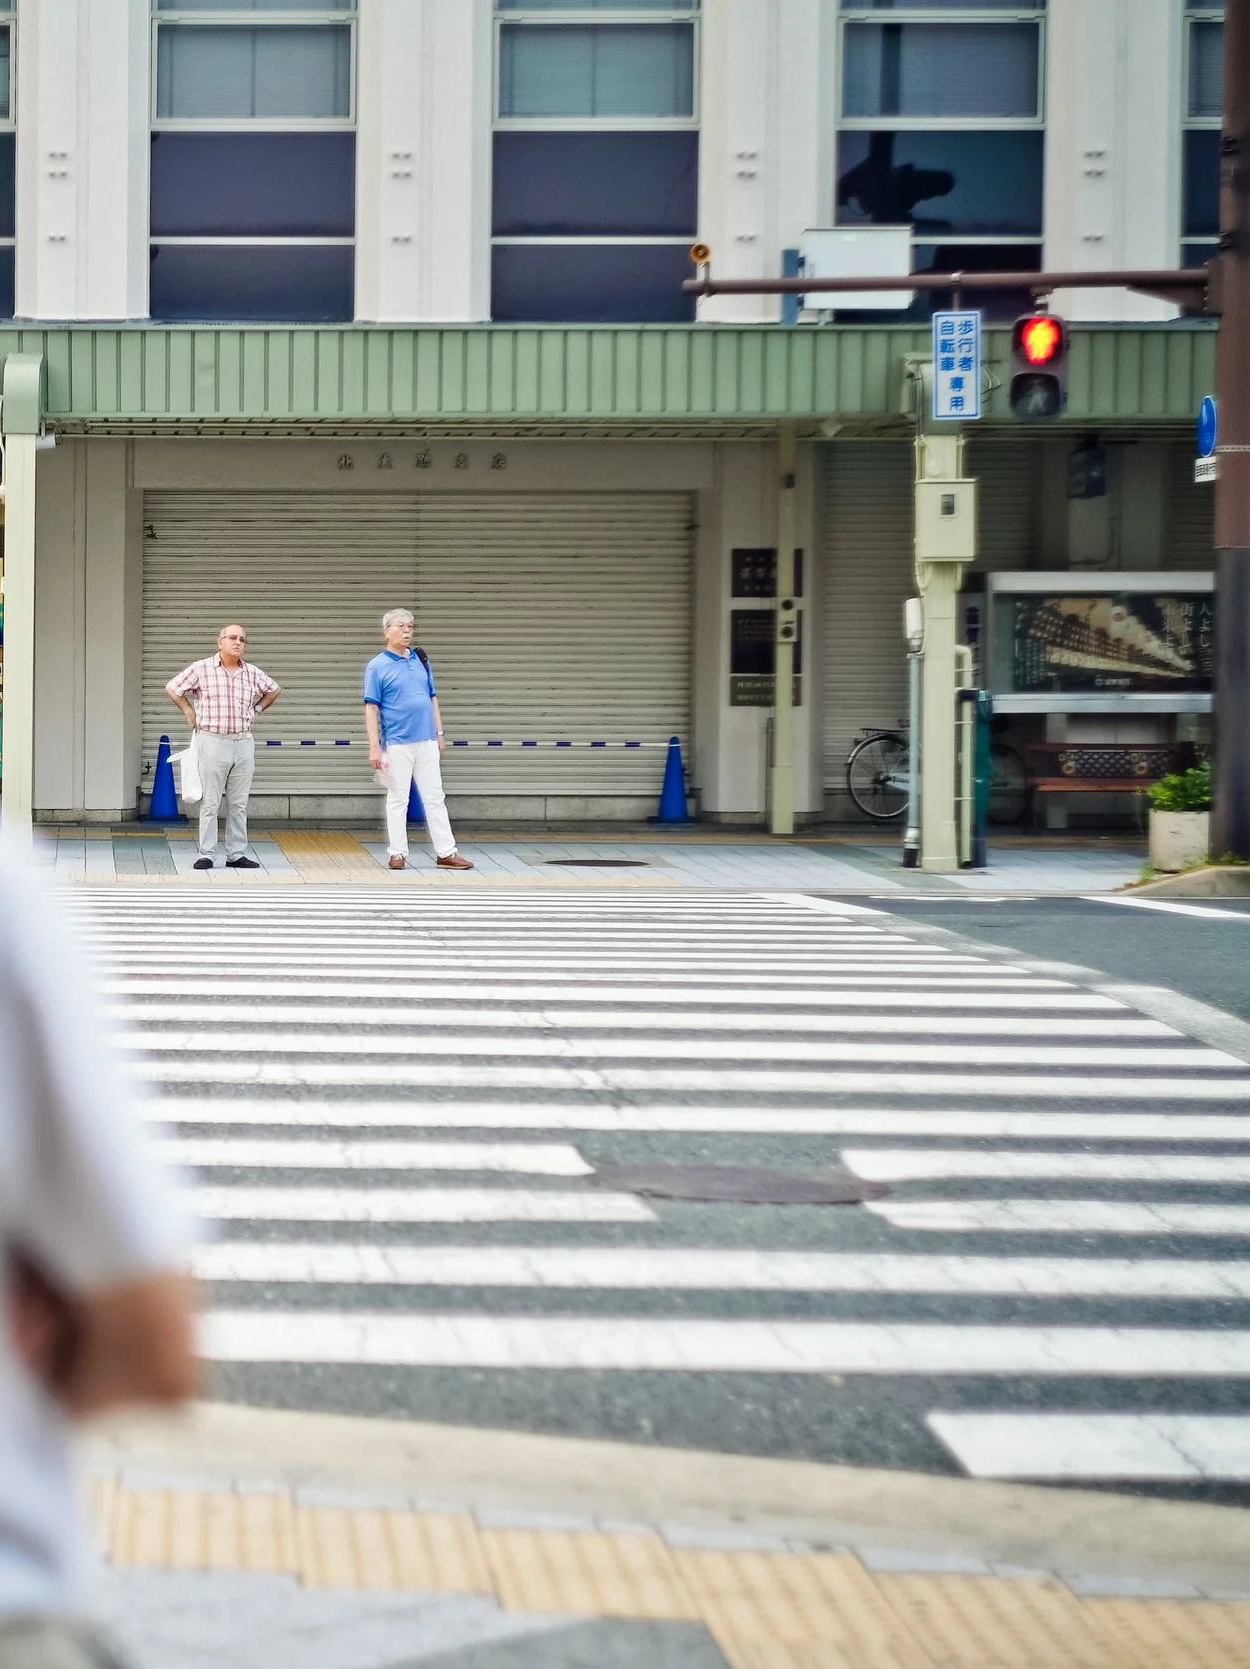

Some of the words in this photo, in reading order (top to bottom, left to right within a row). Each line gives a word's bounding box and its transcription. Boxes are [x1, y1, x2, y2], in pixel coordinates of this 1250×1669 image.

[939, 320, 954, 373] 自転車
[958, 319, 973, 372] 歩行者
[949, 377, 965, 412] 専用
[337, 452, 508, 471] 北大路支店
[1199, 602, 1213, 647] 人よし
